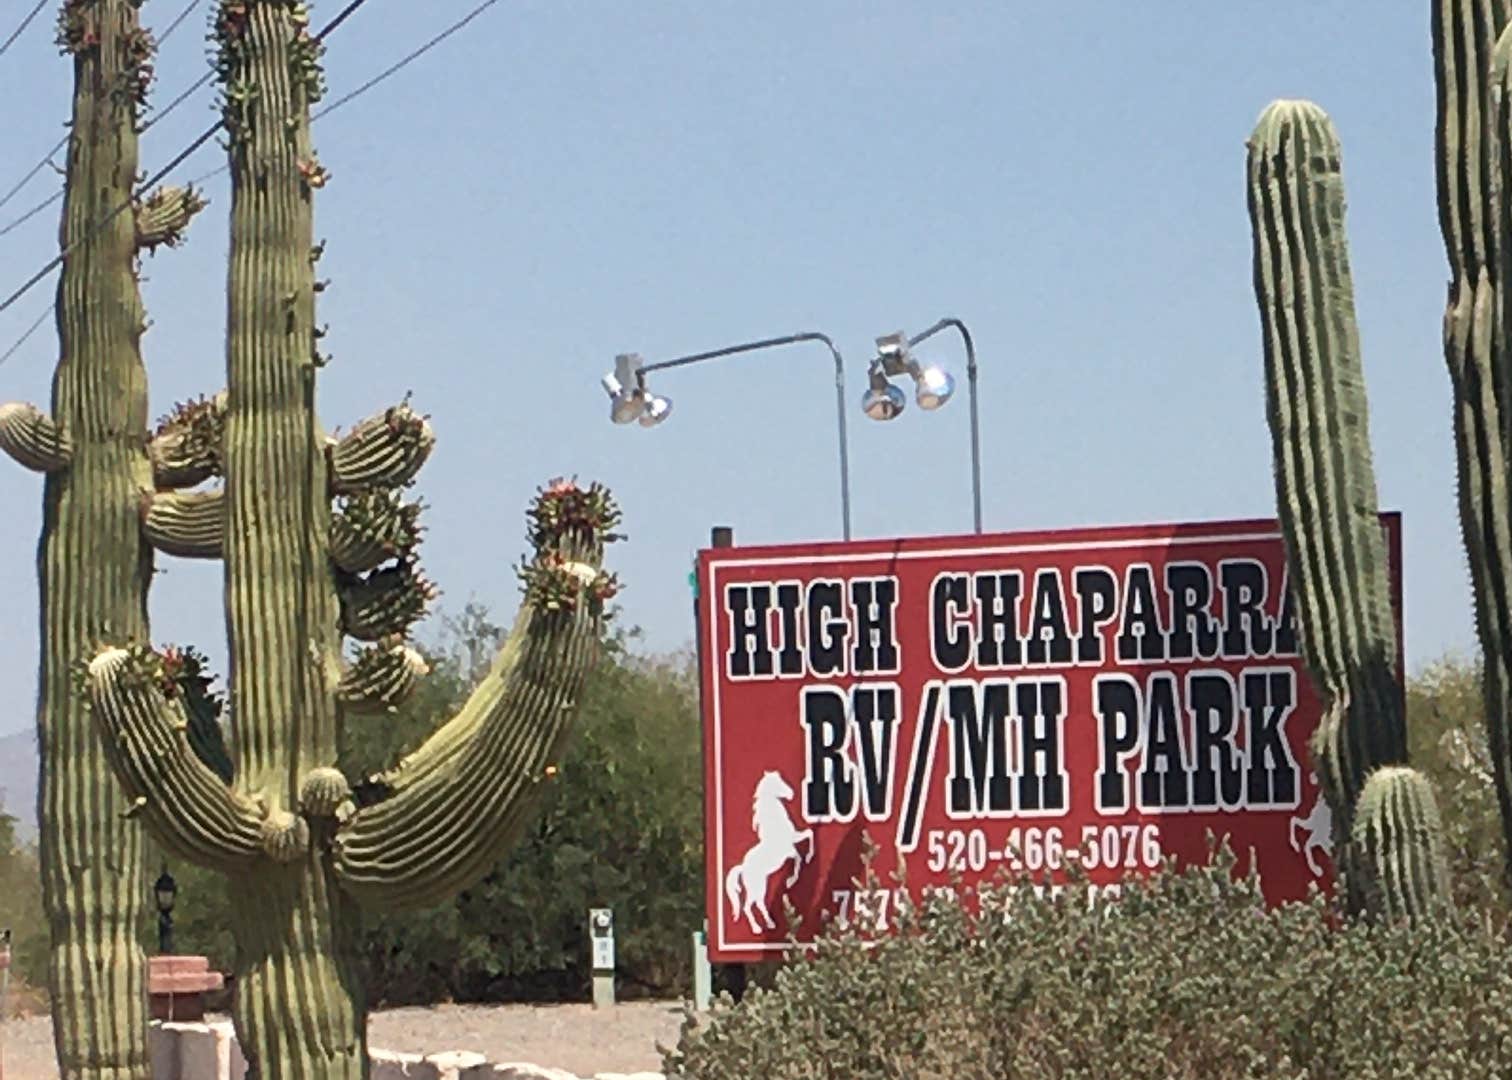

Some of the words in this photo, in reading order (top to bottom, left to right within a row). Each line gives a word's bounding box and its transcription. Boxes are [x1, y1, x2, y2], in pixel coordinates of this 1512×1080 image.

[725, 576, 901, 681] HIGH
[800, 675, 1069, 852] RV/MH
[1094, 667, 1300, 812] PARK
[927, 823, 1162, 872] 520-466-5076
